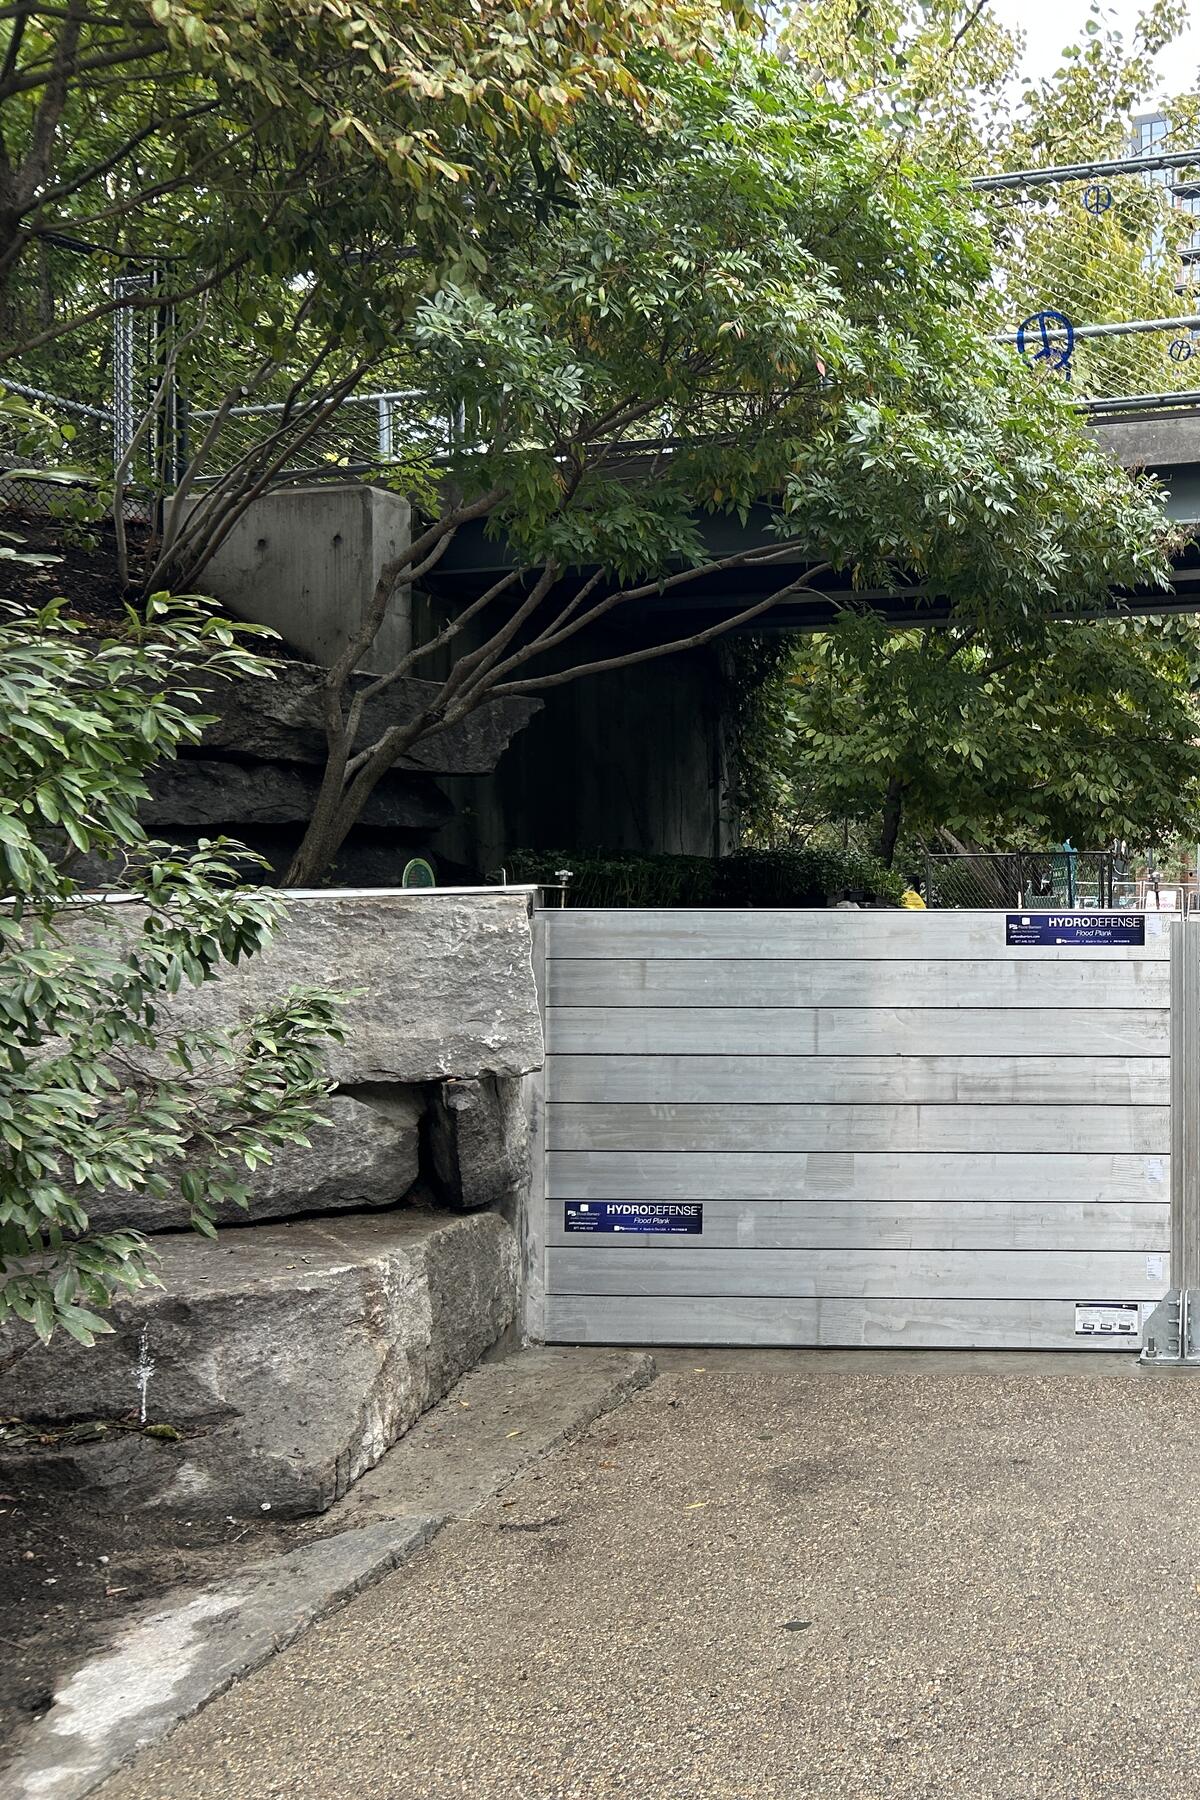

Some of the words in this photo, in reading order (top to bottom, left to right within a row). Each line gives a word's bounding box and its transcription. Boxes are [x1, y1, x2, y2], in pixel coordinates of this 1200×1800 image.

[1048, 917, 1140, 928] HYDRODEFENSE
[1075, 929, 1094, 937] Flood
[606, 1204, 698, 1216] HYDRODEFENSE
[633, 1216, 652, 1224] Flood
[652, 1217, 671, 1225] Plank
